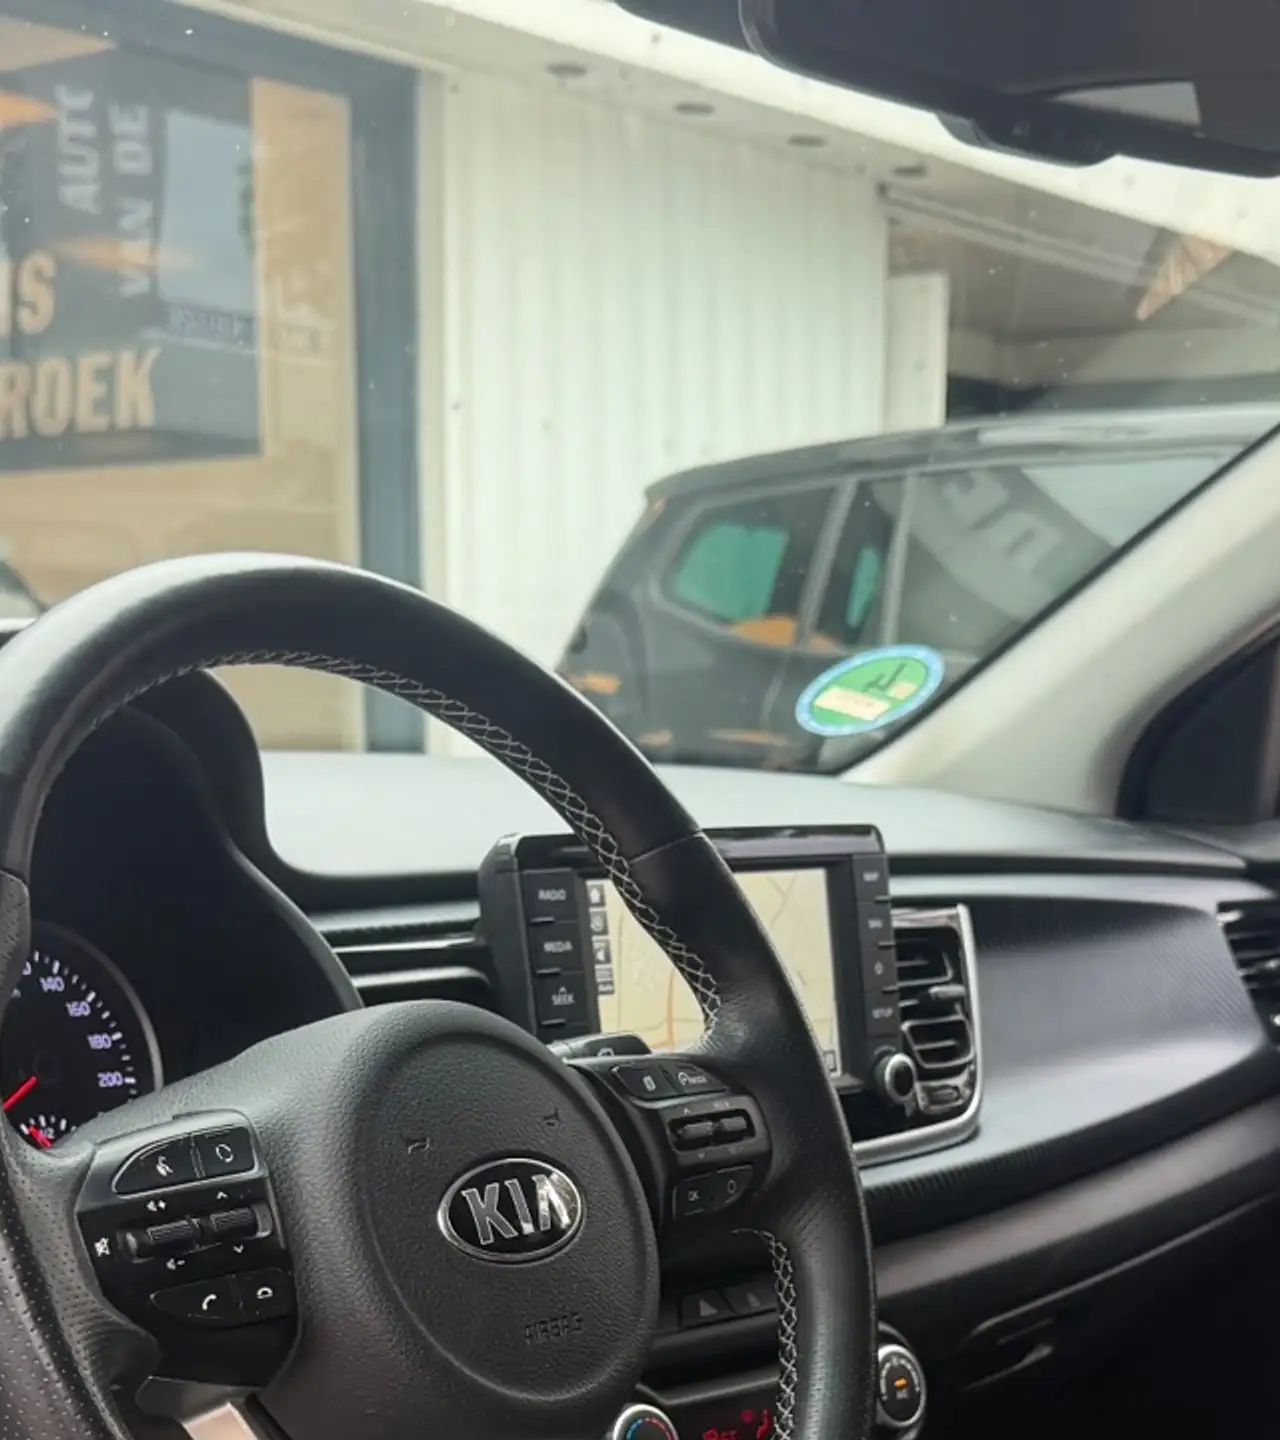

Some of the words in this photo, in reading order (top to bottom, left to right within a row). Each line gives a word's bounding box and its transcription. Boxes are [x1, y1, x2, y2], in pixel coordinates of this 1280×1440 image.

[40, 976, 65, 992] 140
[66, 1001, 91, 1017] 160
[88, 1033, 113, 1050] 180
[97, 1071, 124, 1088] 200
[461, 1171, 571, 1246] KIA
